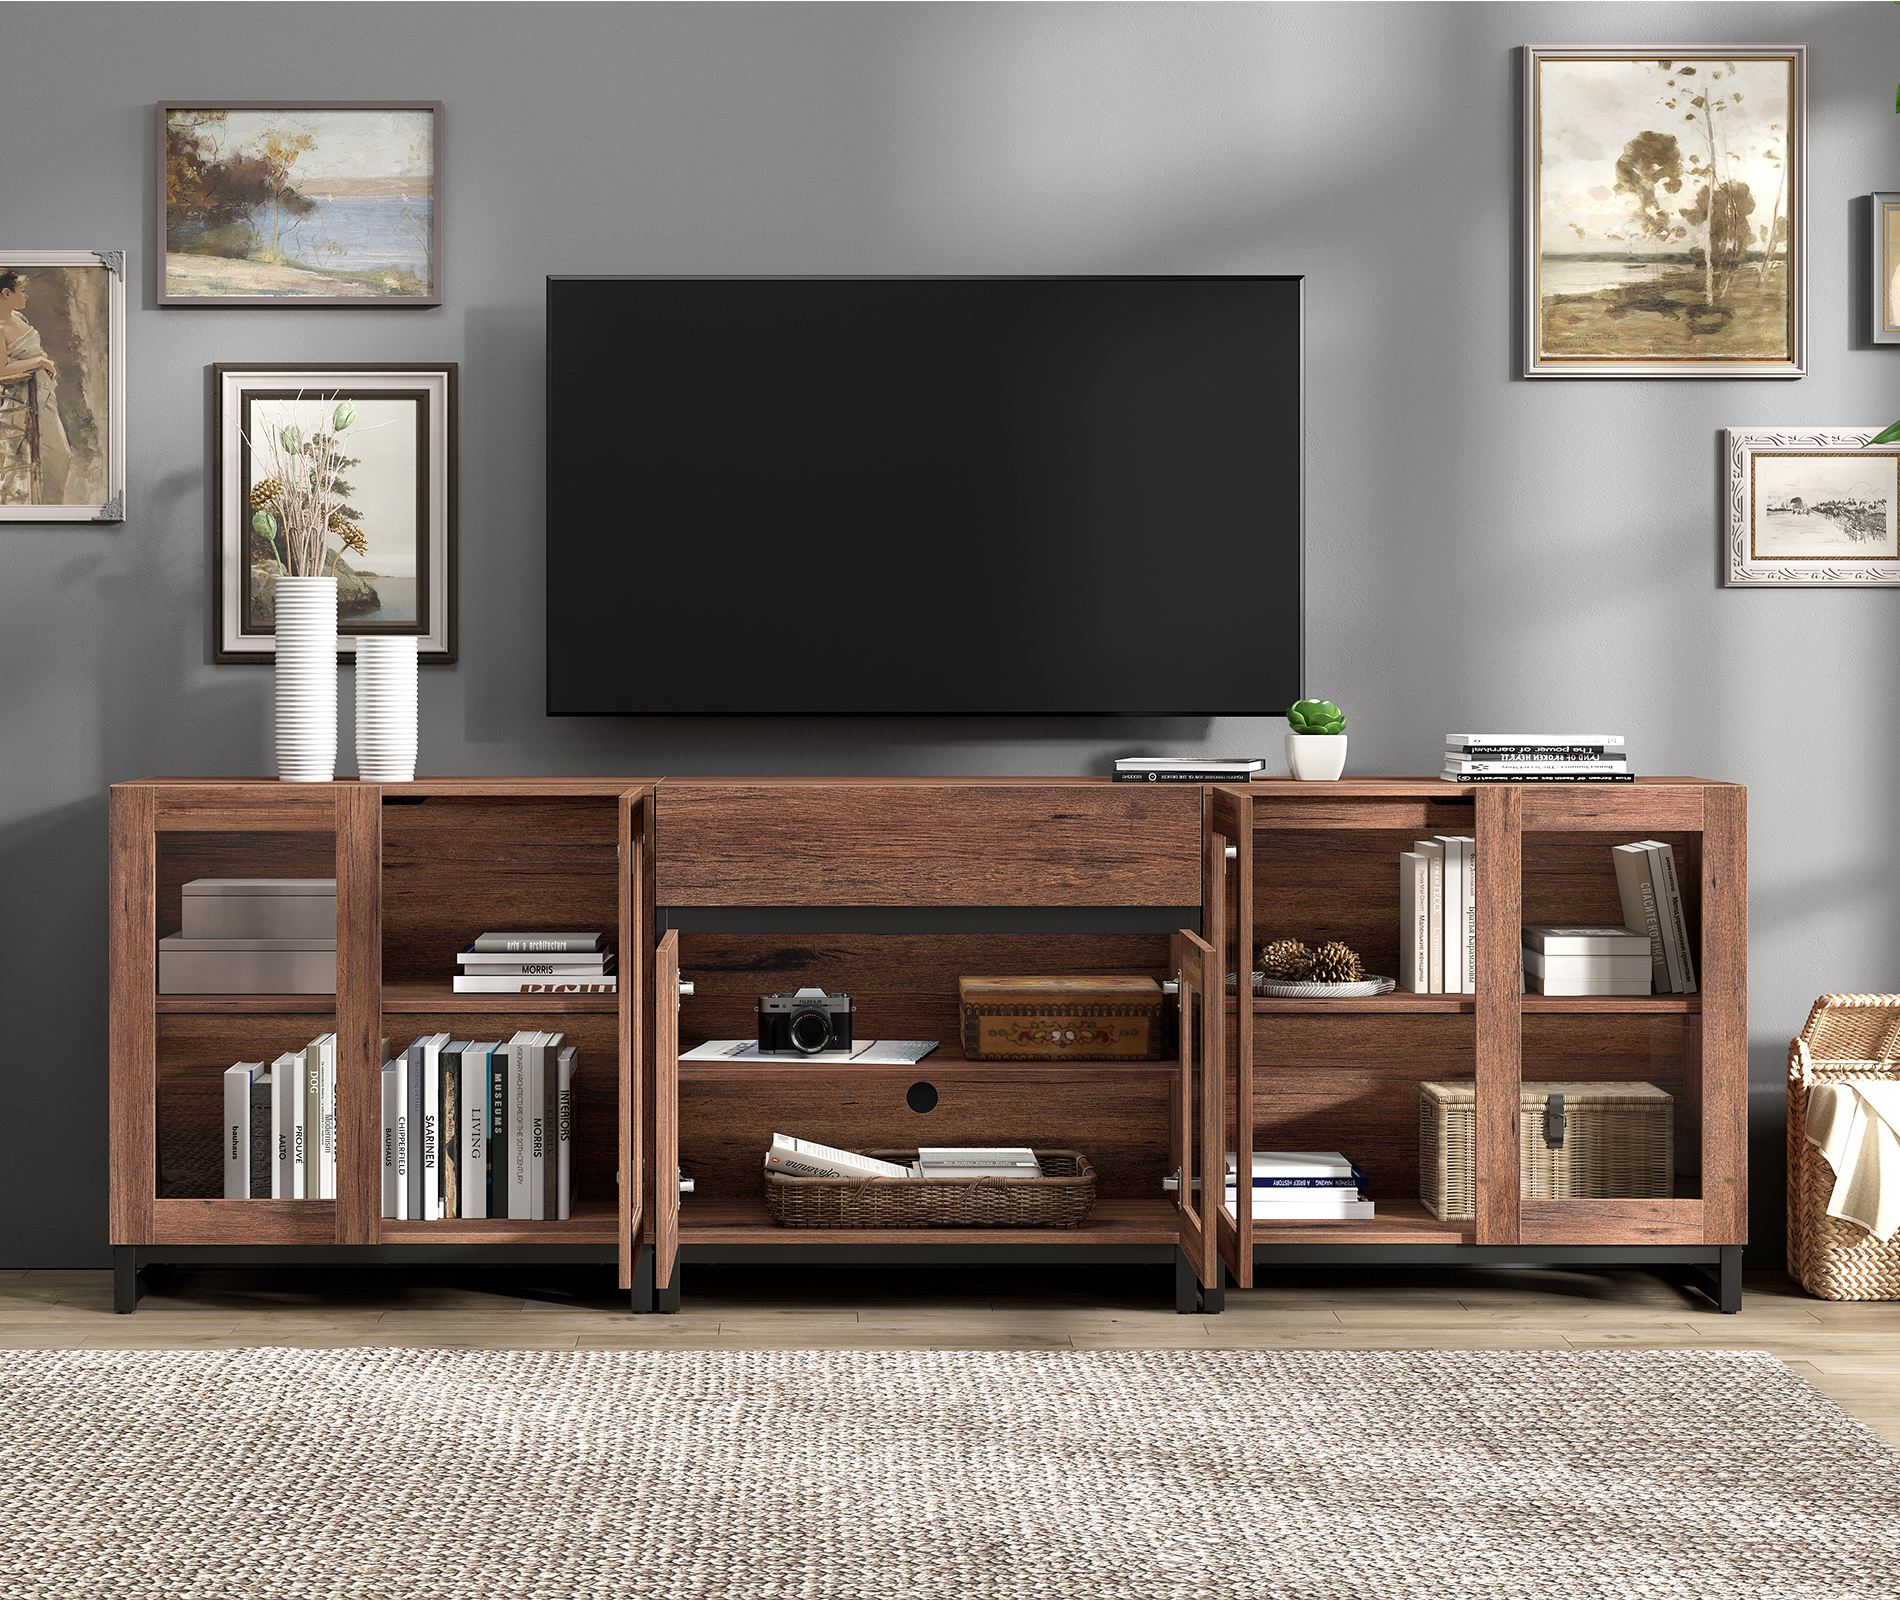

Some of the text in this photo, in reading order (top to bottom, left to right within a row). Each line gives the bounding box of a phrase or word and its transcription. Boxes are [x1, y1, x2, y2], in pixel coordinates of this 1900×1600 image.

[1517, 746, 1532, 754] of
[1534, 745, 1570, 754] power
[1572, 746, 1595, 754] The
[1433, 886, 1441, 915] ГЕССЕ
[1640, 882, 1664, 965] СПАСИТЕ КОТИКА!
[529, 940, 567, 951] architecture
[1433, 926, 1442, 964] Степной
[521, 965, 554, 975] MORRIS
[309, 1070, 319, 1094] DOG
[494, 1073, 503, 1134] MUSEUMS
[516, 1045, 524, 1185] VISIONARY ARCHITECTURE OF THE 20TH CENTURY
[560, 1089, 570, 1142] INTERIORS
[254, 1103, 264, 1188] CONCRETE
[278, 1133, 287, 1161] AALTO
[295, 1125, 304, 1164] PROUVÉ
[325, 1114, 333, 1154] Modernism
[398, 1116, 406, 1176] CHIPPERFIELD
[425, 1115, 435, 1169] SAARINEN
[471, 1108, 481, 1159] LIVING
[533, 1118, 542, 1158] MORRIS
[546, 1109, 554, 1155] KINFOLK
[1272, 1179, 1293, 1187] HISTORY
[1335, 1179, 1356, 1187] STEPHEN
